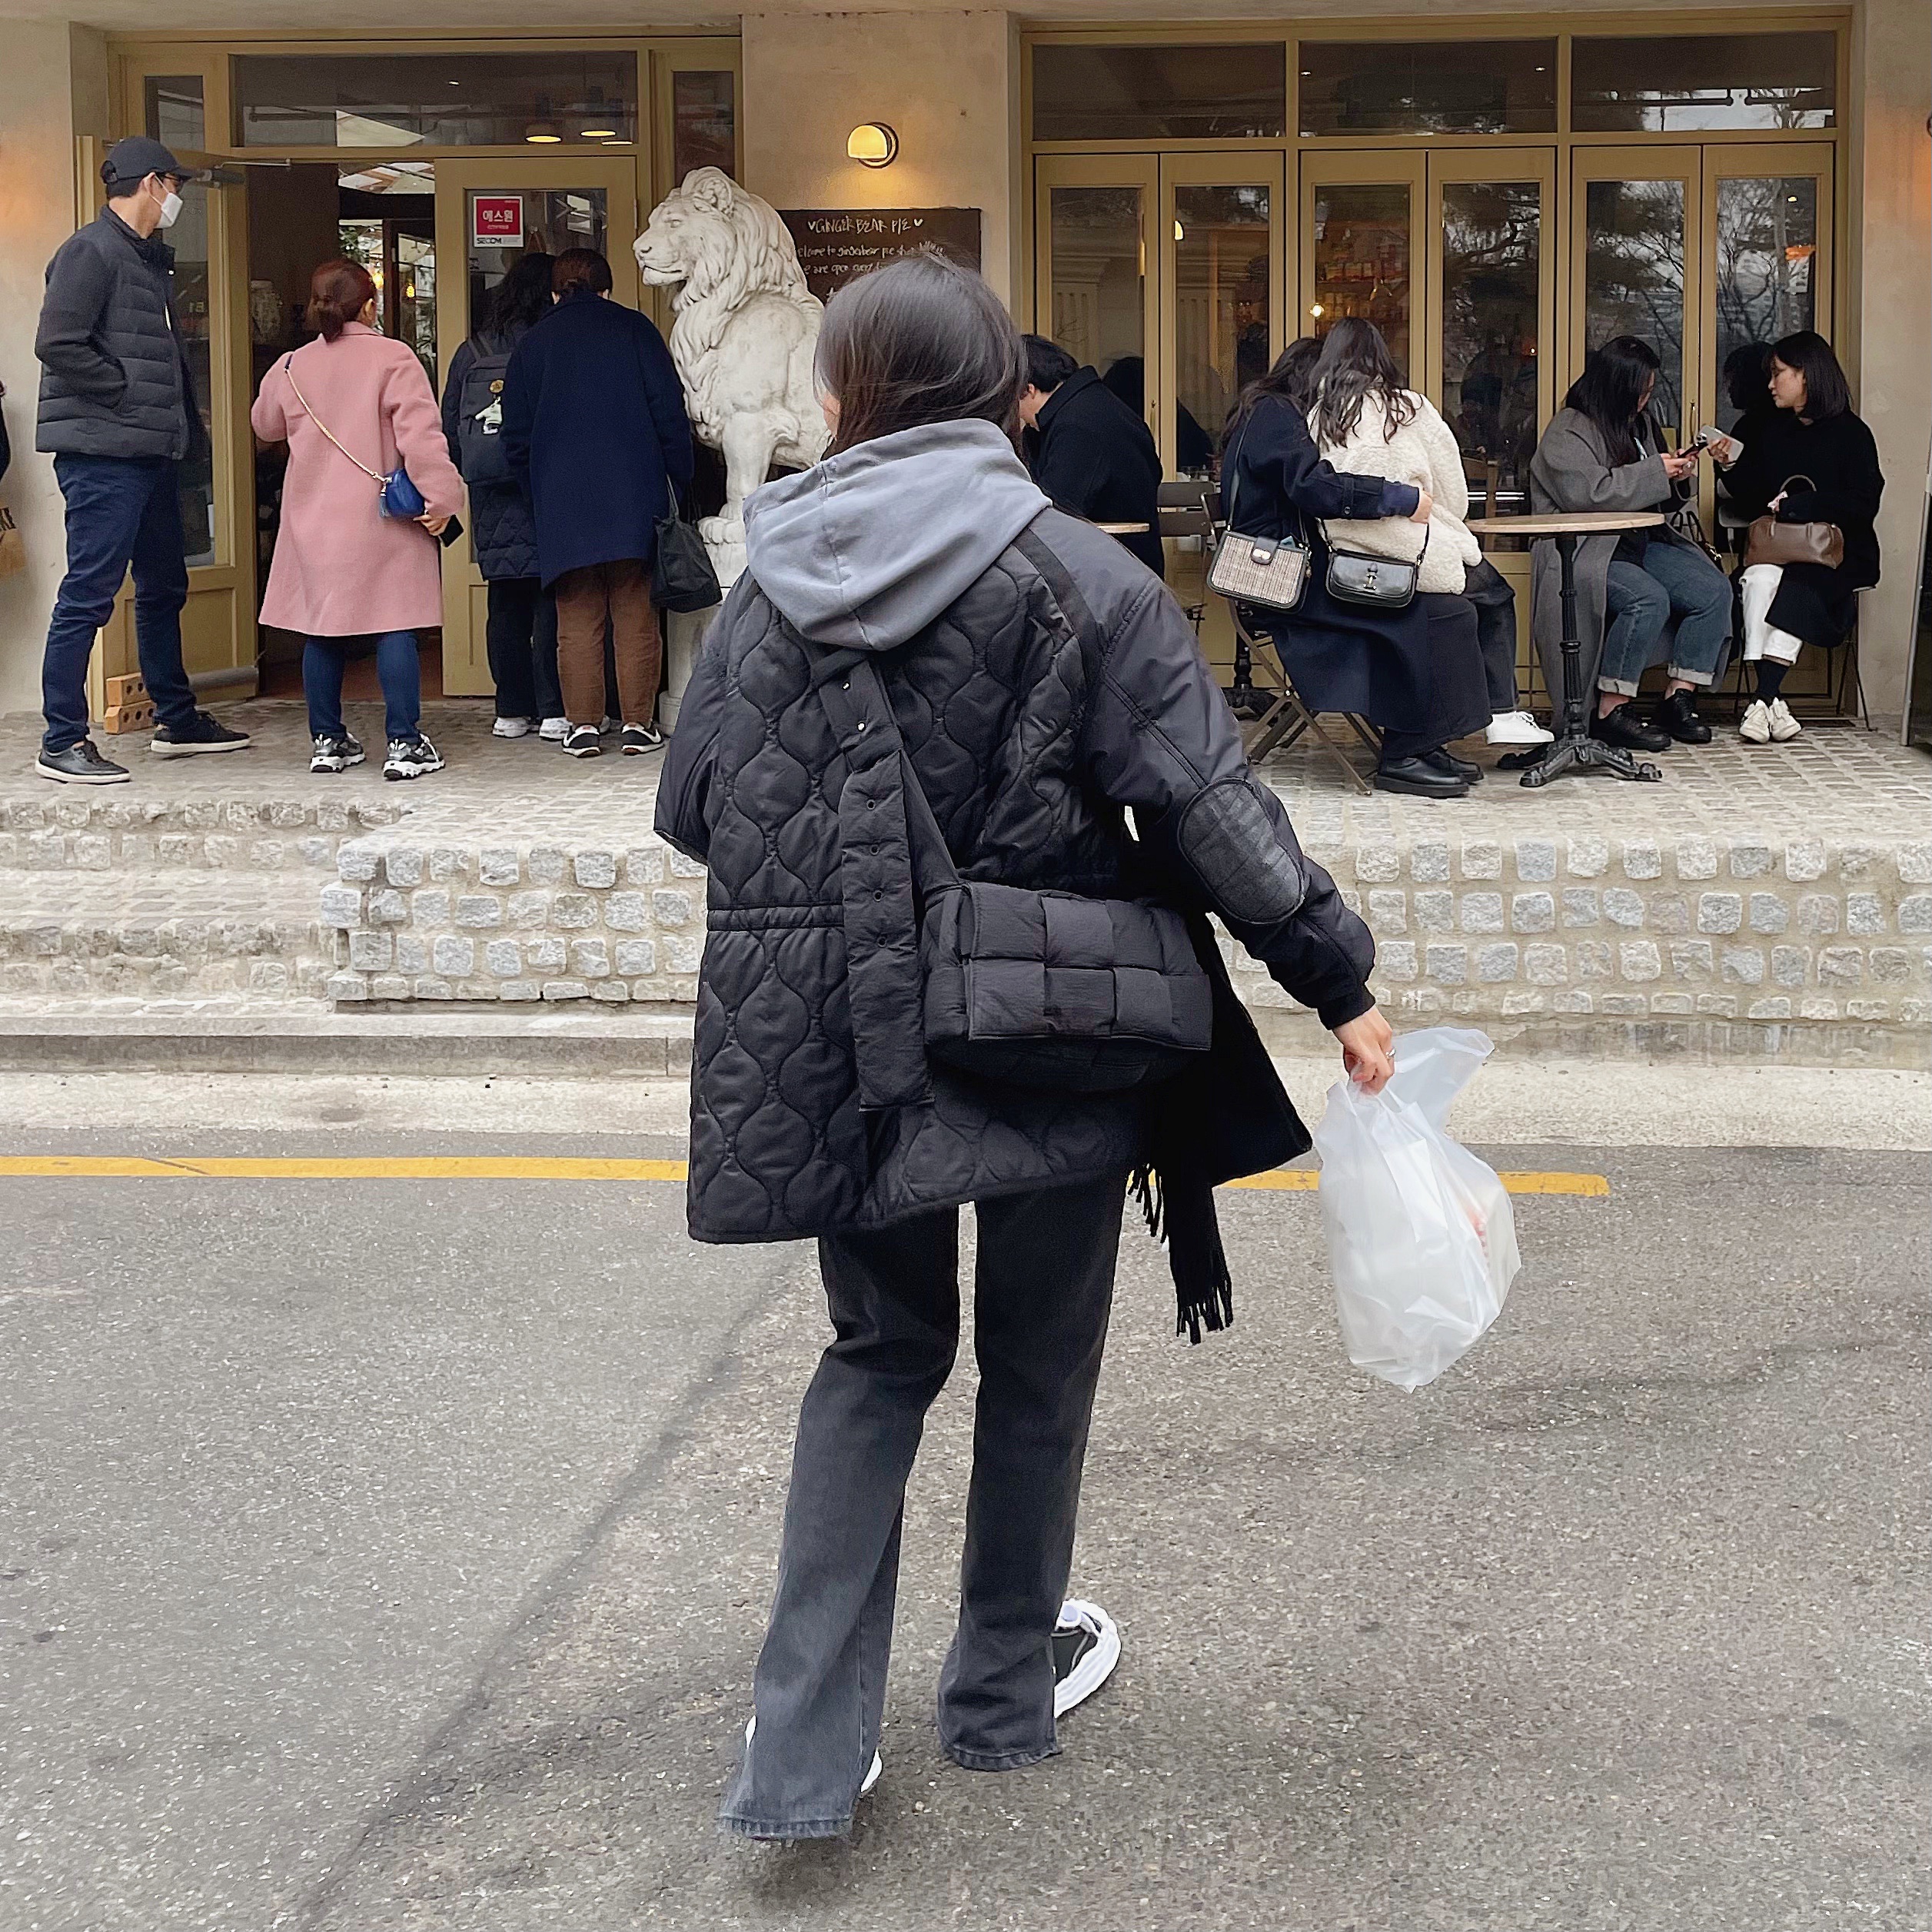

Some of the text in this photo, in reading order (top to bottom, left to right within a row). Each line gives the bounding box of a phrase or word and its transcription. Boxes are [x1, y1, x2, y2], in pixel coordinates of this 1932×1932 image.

[482, 209, 514, 223] 에스원
[892, 218, 912, 234] PIE
[797, 244, 826, 258] elcome
